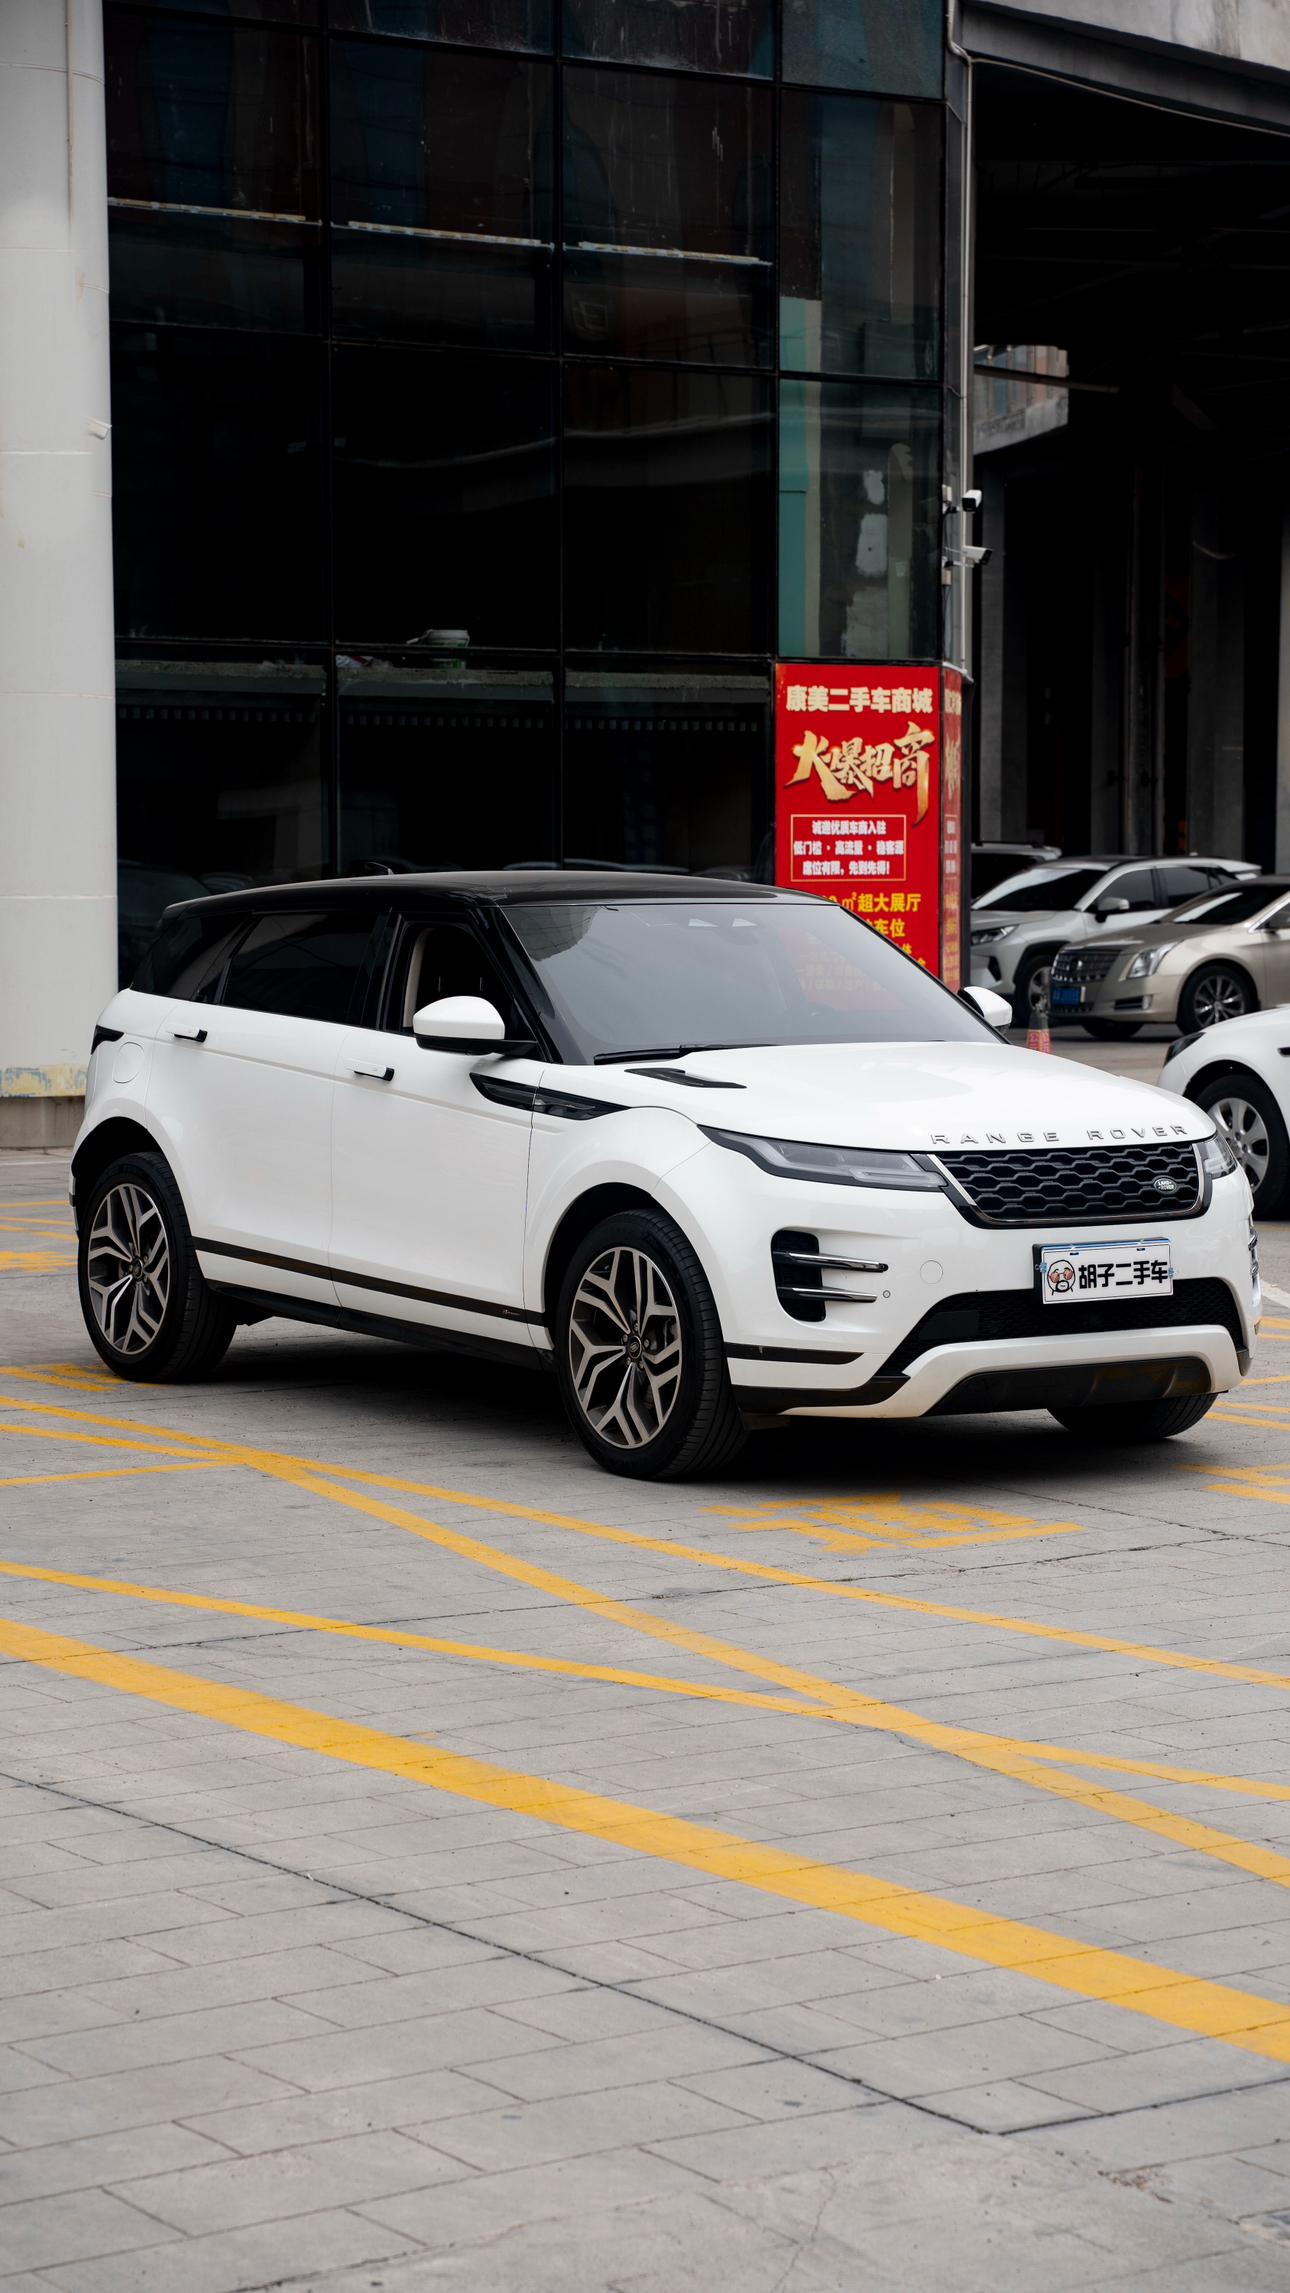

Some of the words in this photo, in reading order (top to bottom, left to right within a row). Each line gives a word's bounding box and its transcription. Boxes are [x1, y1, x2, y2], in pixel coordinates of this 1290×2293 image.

[786, 685, 933, 713] 康美二手车商城
[784, 721, 935, 827] 火爆招商
[930, 1131, 1060, 1145] RANGE
[1086, 1124, 1188, 1141] ROVER
[1078, 1260, 1168, 1289] 胡子二手车
